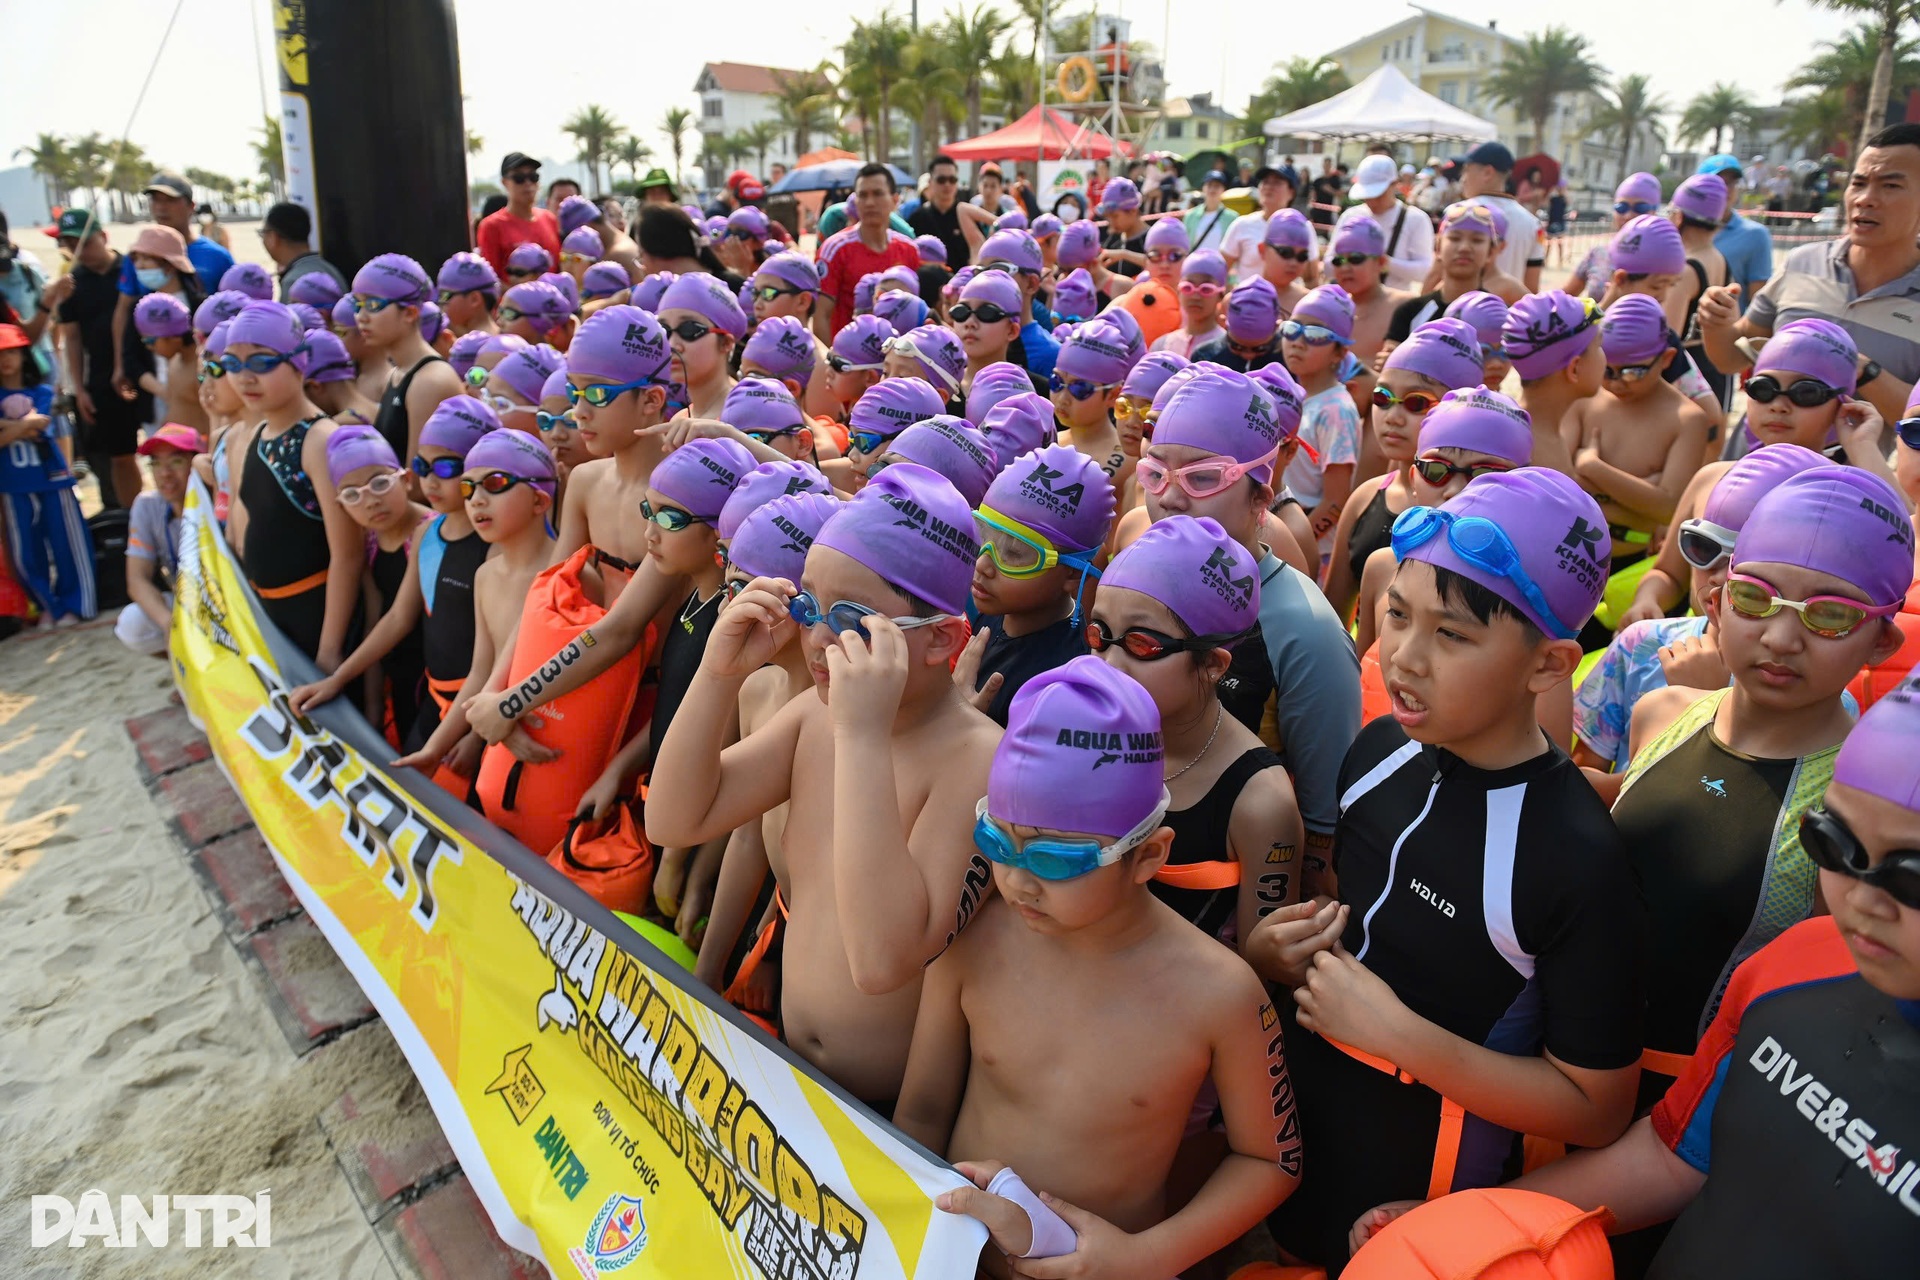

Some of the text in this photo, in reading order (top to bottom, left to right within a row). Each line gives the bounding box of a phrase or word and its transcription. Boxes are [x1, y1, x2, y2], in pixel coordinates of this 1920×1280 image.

[621, 341, 653, 355] KHANG
[624, 323, 664, 349] KA
[780, 330, 807, 355] KA
[1439, 334, 1472, 353] AQUA
[625, 349, 660, 362] SPORTS
[745, 391, 776, 400] AQUA
[454, 411, 483, 426] AQUA
[878, 406, 912, 420] AQUA
[1244, 413, 1275, 437] KHANG
[699, 456, 736, 483] AQUA
[1026, 462, 1084, 507] KA
[878, 493, 928, 526] AQUA
[1020, 480, 1076, 516] KHANG AN
[1020, 489, 1067, 519] SPORTS
[771, 515, 813, 551] AQUA
[1860, 497, 1910, 540] AQUA
[921, 528, 961, 558] HALONG
[1205, 546, 1254, 602] KA
[1554, 544, 1600, 583] KHANG
[1199, 564, 1249, 610] KHANG AN
[1201, 576, 1240, 613] SPORTS
[499, 643, 581, 719] 3328
[1056, 728, 1123, 751] AQUA
[1264, 841, 1296, 864] AW
[577, 1008, 684, 1159] HALONG
[682, 1119, 753, 1232] BAY
[1256, 1031, 1302, 1178] 3245
[1748, 1035, 1920, 1217] DIVE&SAIL
[593, 1100, 661, 1195] ĐƠN VỊ TỔ CHỨC
[747, 1233, 778, 1280] 2025
